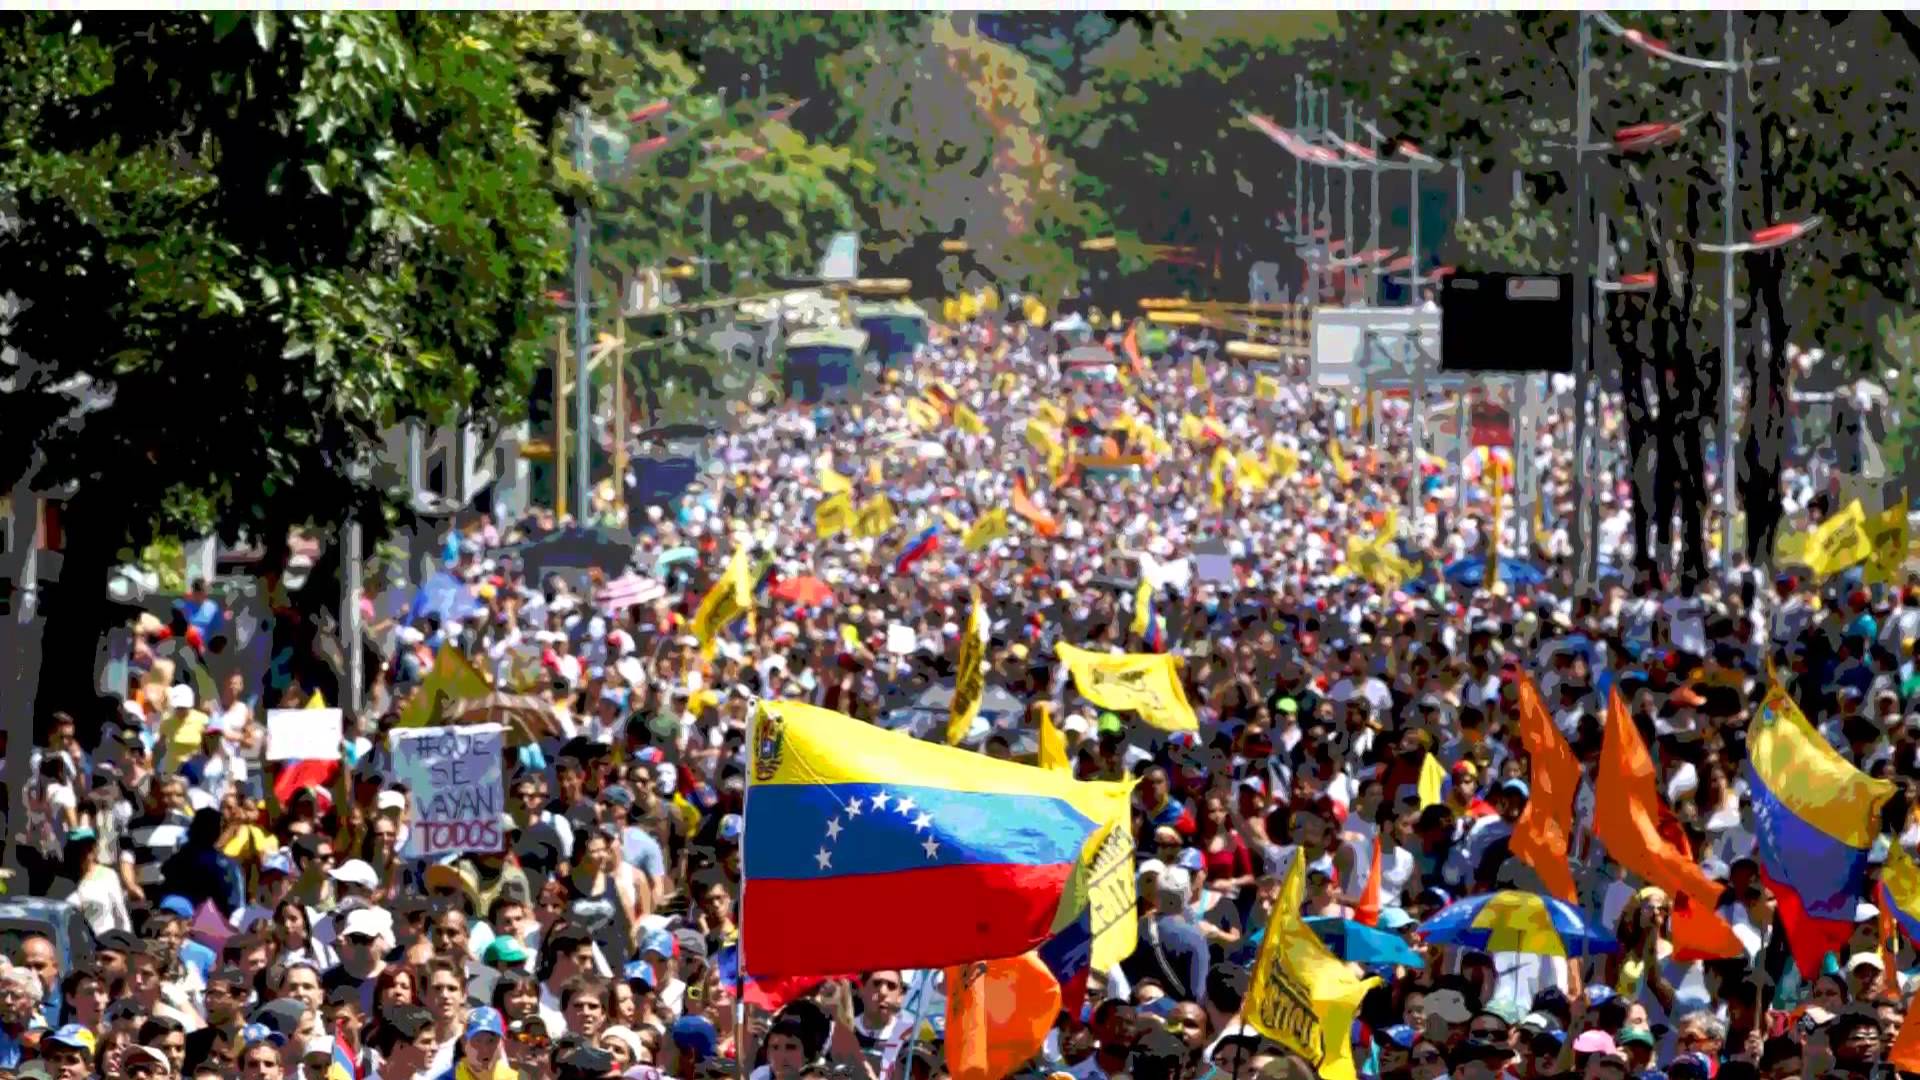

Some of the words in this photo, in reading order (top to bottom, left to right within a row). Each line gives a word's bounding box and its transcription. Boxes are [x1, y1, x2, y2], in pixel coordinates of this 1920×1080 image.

[431, 761, 471, 785] SE
[416, 786, 494, 820] VAYAN
[415, 820, 498, 852] TODOS
